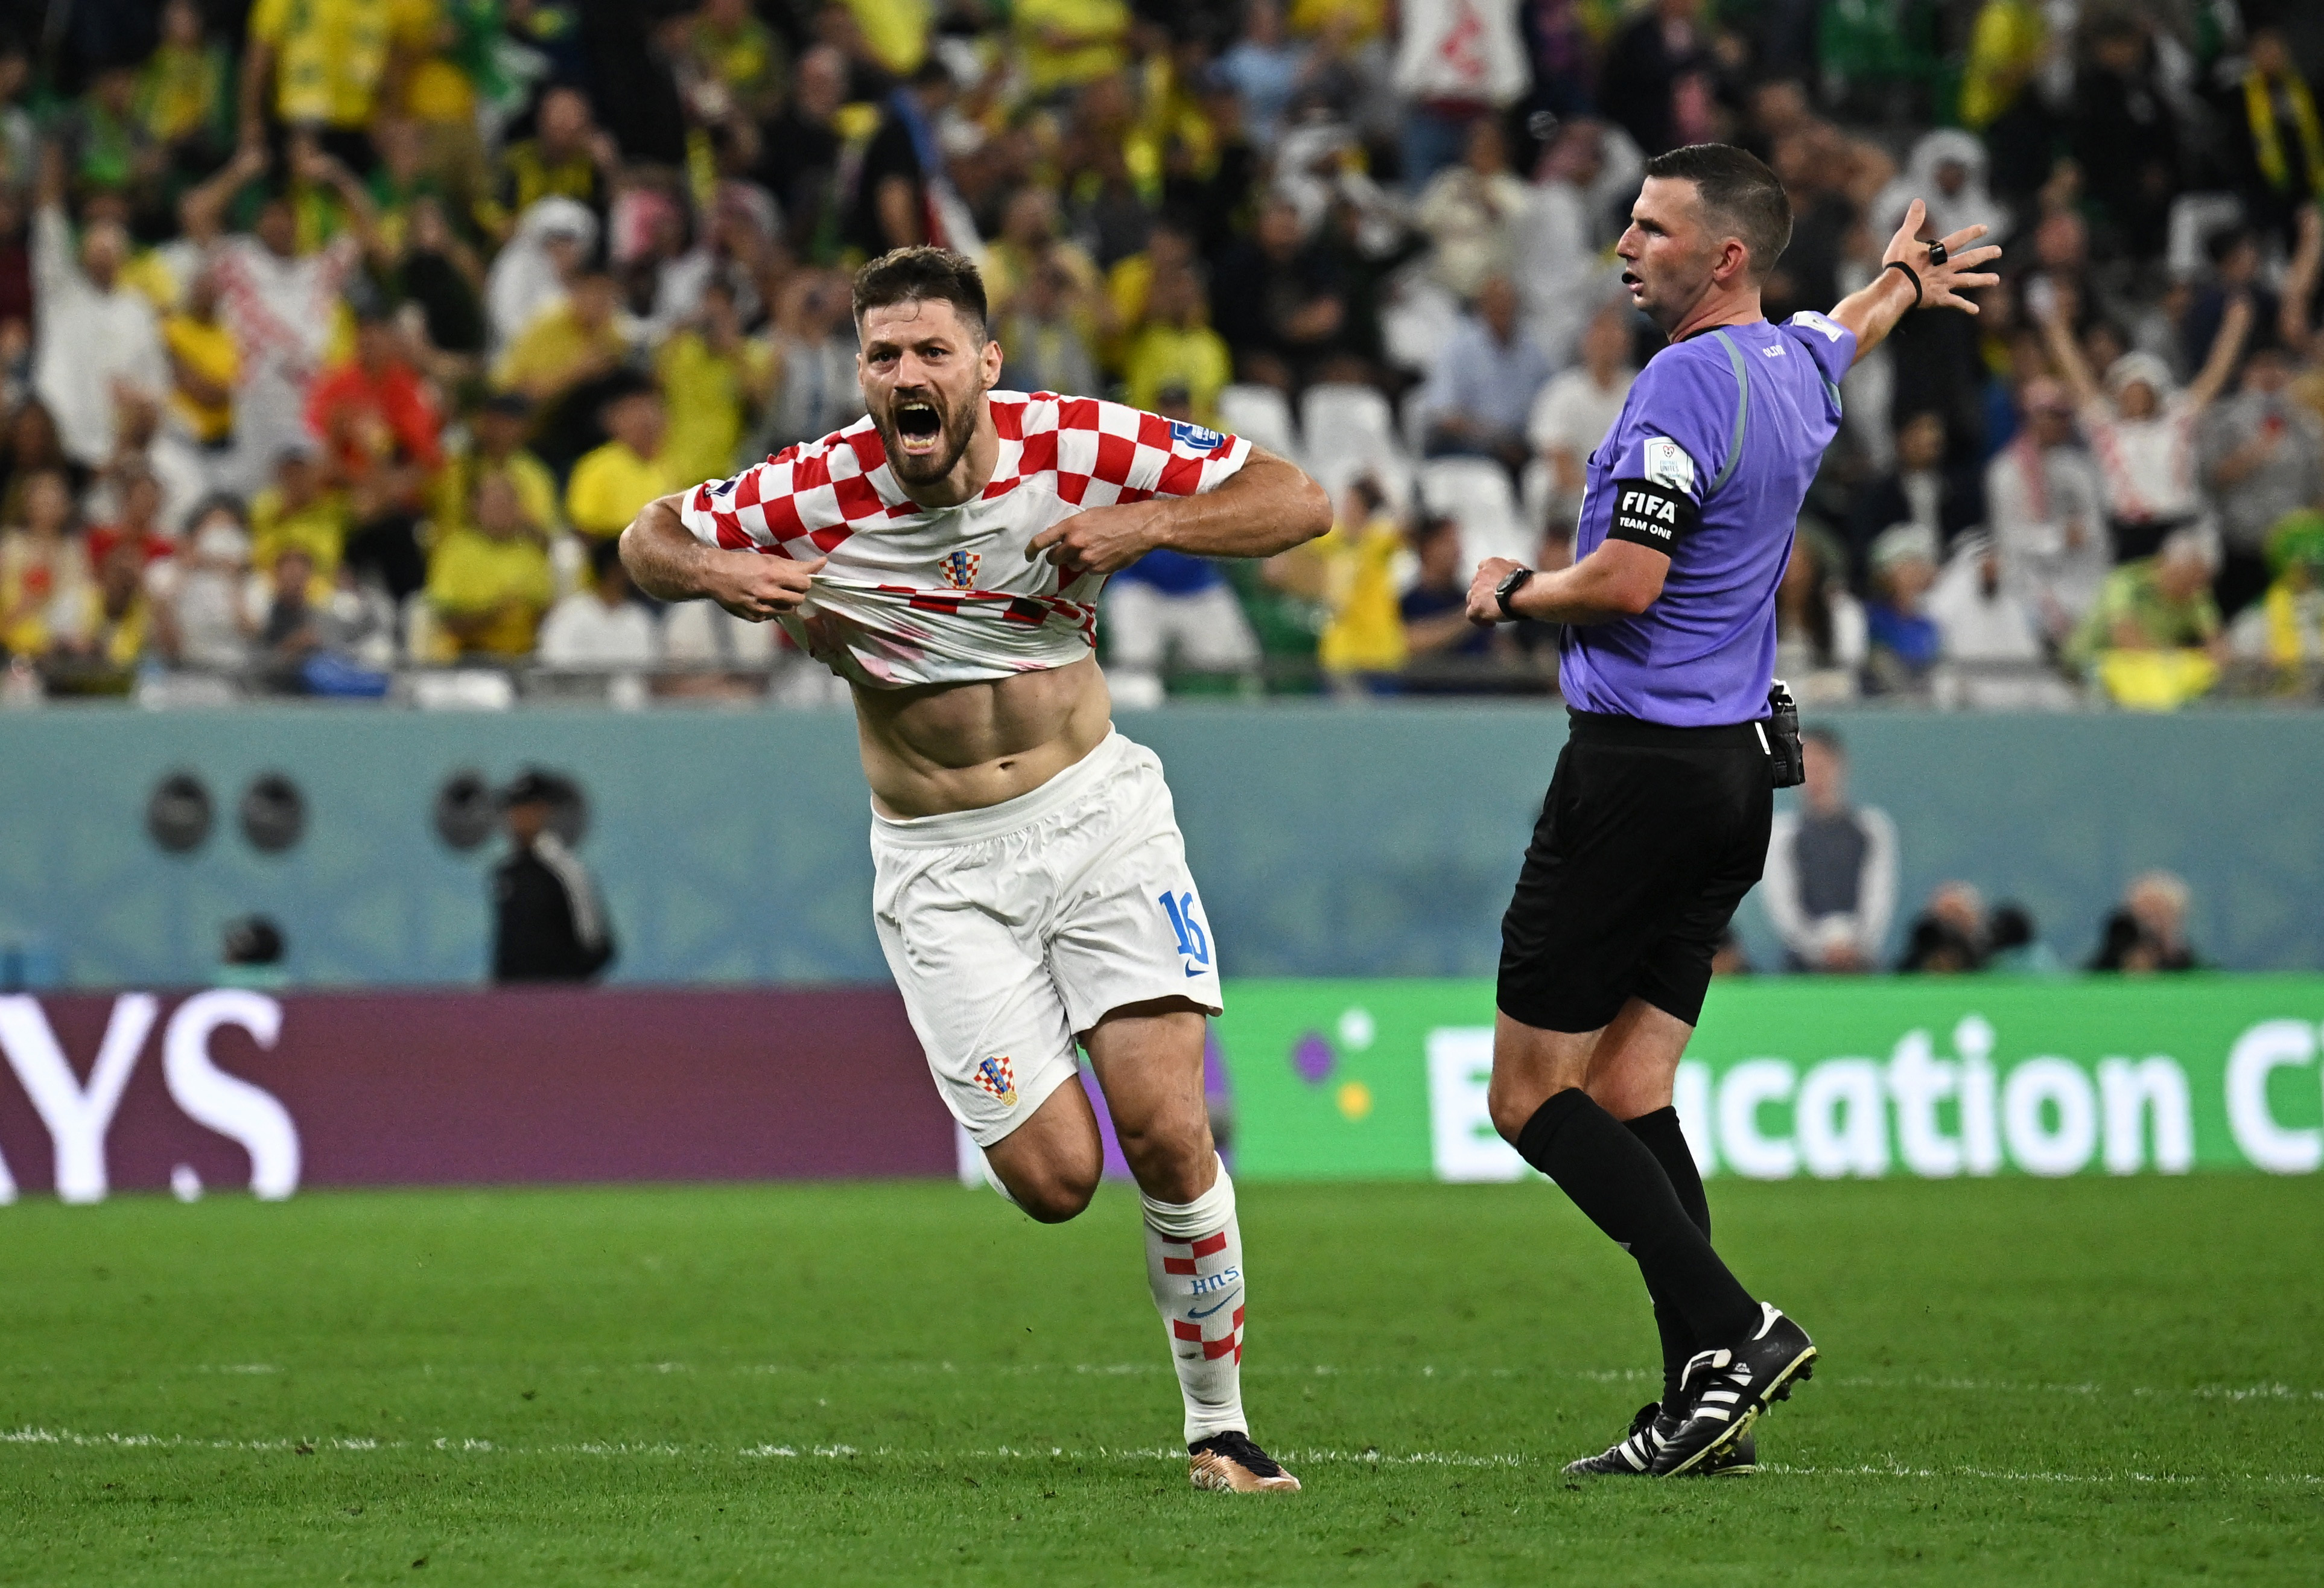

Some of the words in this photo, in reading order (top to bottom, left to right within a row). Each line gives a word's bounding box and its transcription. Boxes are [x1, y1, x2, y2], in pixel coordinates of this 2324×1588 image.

[1620, 517, 1648, 531] TEAM
[1649, 524, 1672, 540] ONE
[1622, 491, 1675, 524] FIFA
[1158, 890, 1209, 965] 16
[0, 988, 302, 1204] YS
[1427, 1015, 2194, 1181] Ecation
[2225, 1020, 2324, 1175] C
